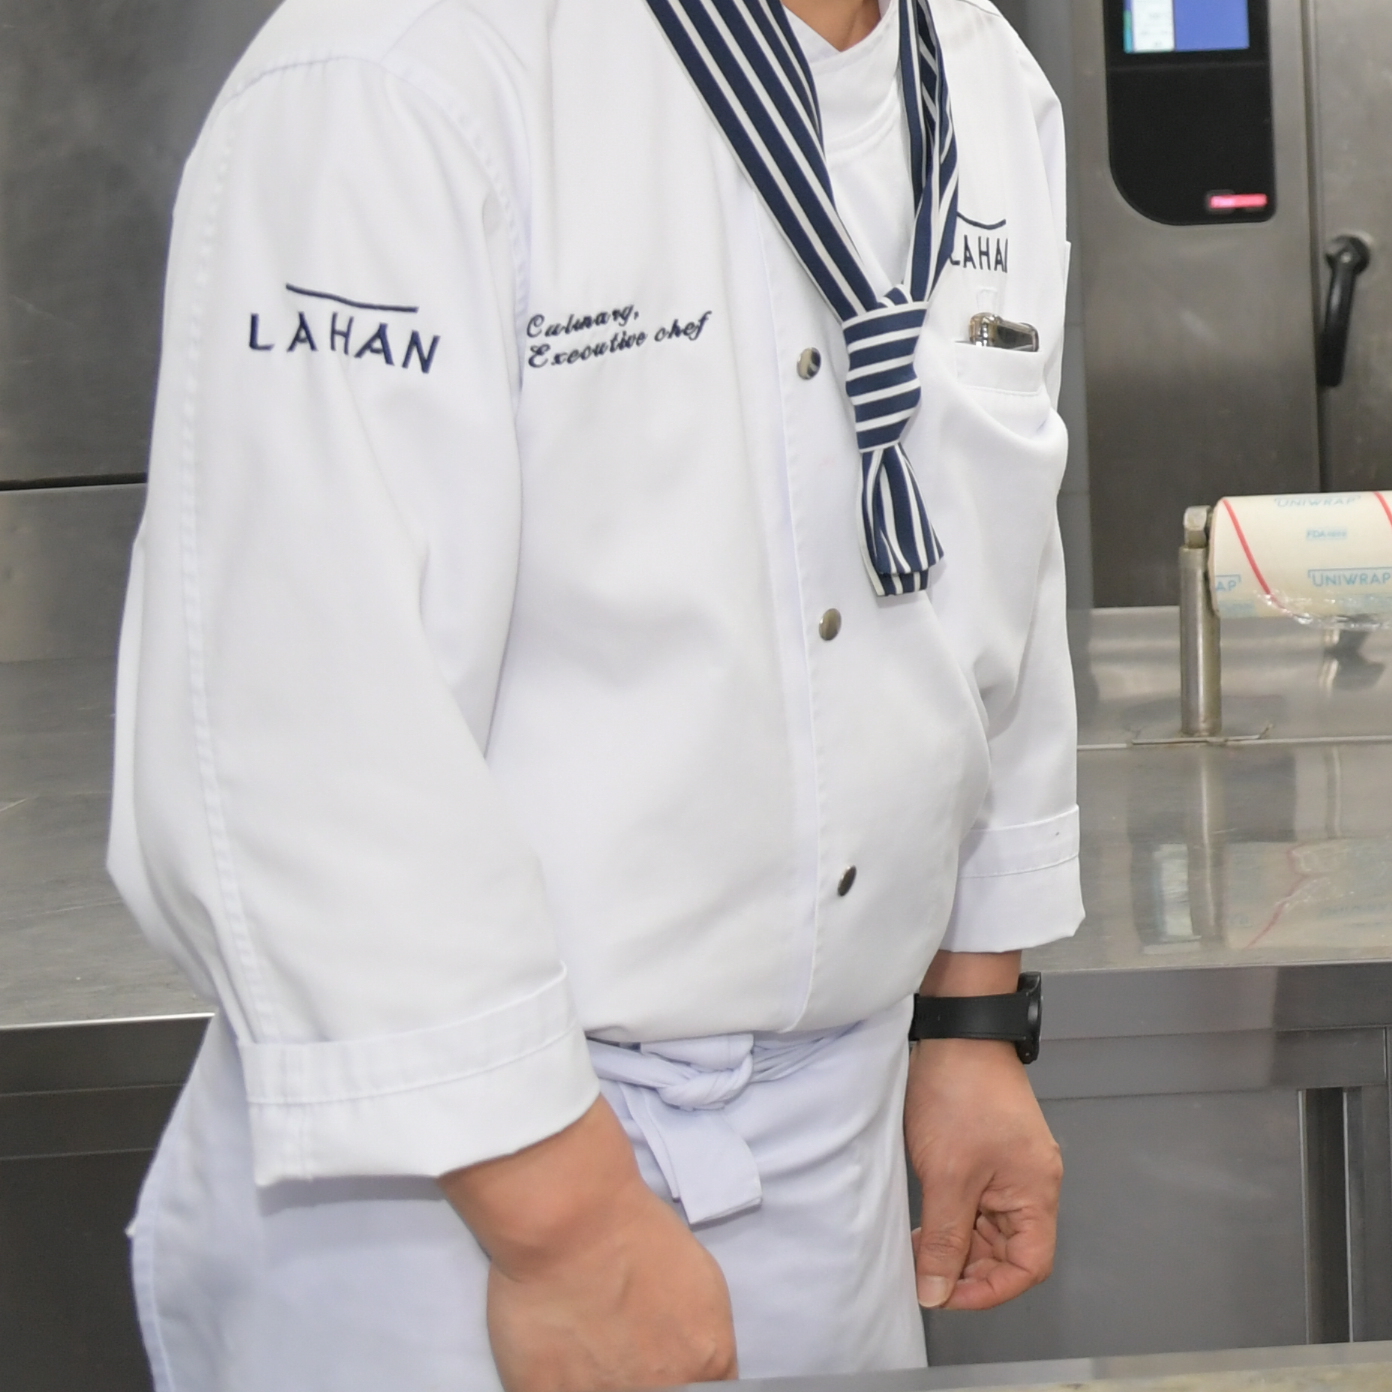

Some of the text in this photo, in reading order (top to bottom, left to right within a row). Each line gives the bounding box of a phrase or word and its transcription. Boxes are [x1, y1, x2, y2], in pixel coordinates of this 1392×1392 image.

[249, 311, 441, 374] LAHAN
[528, 310, 712, 368] Executive chef
[1276, 496, 1356, 508] UNIWRAP
[1312, 571, 1392, 588] UNIWRAP
